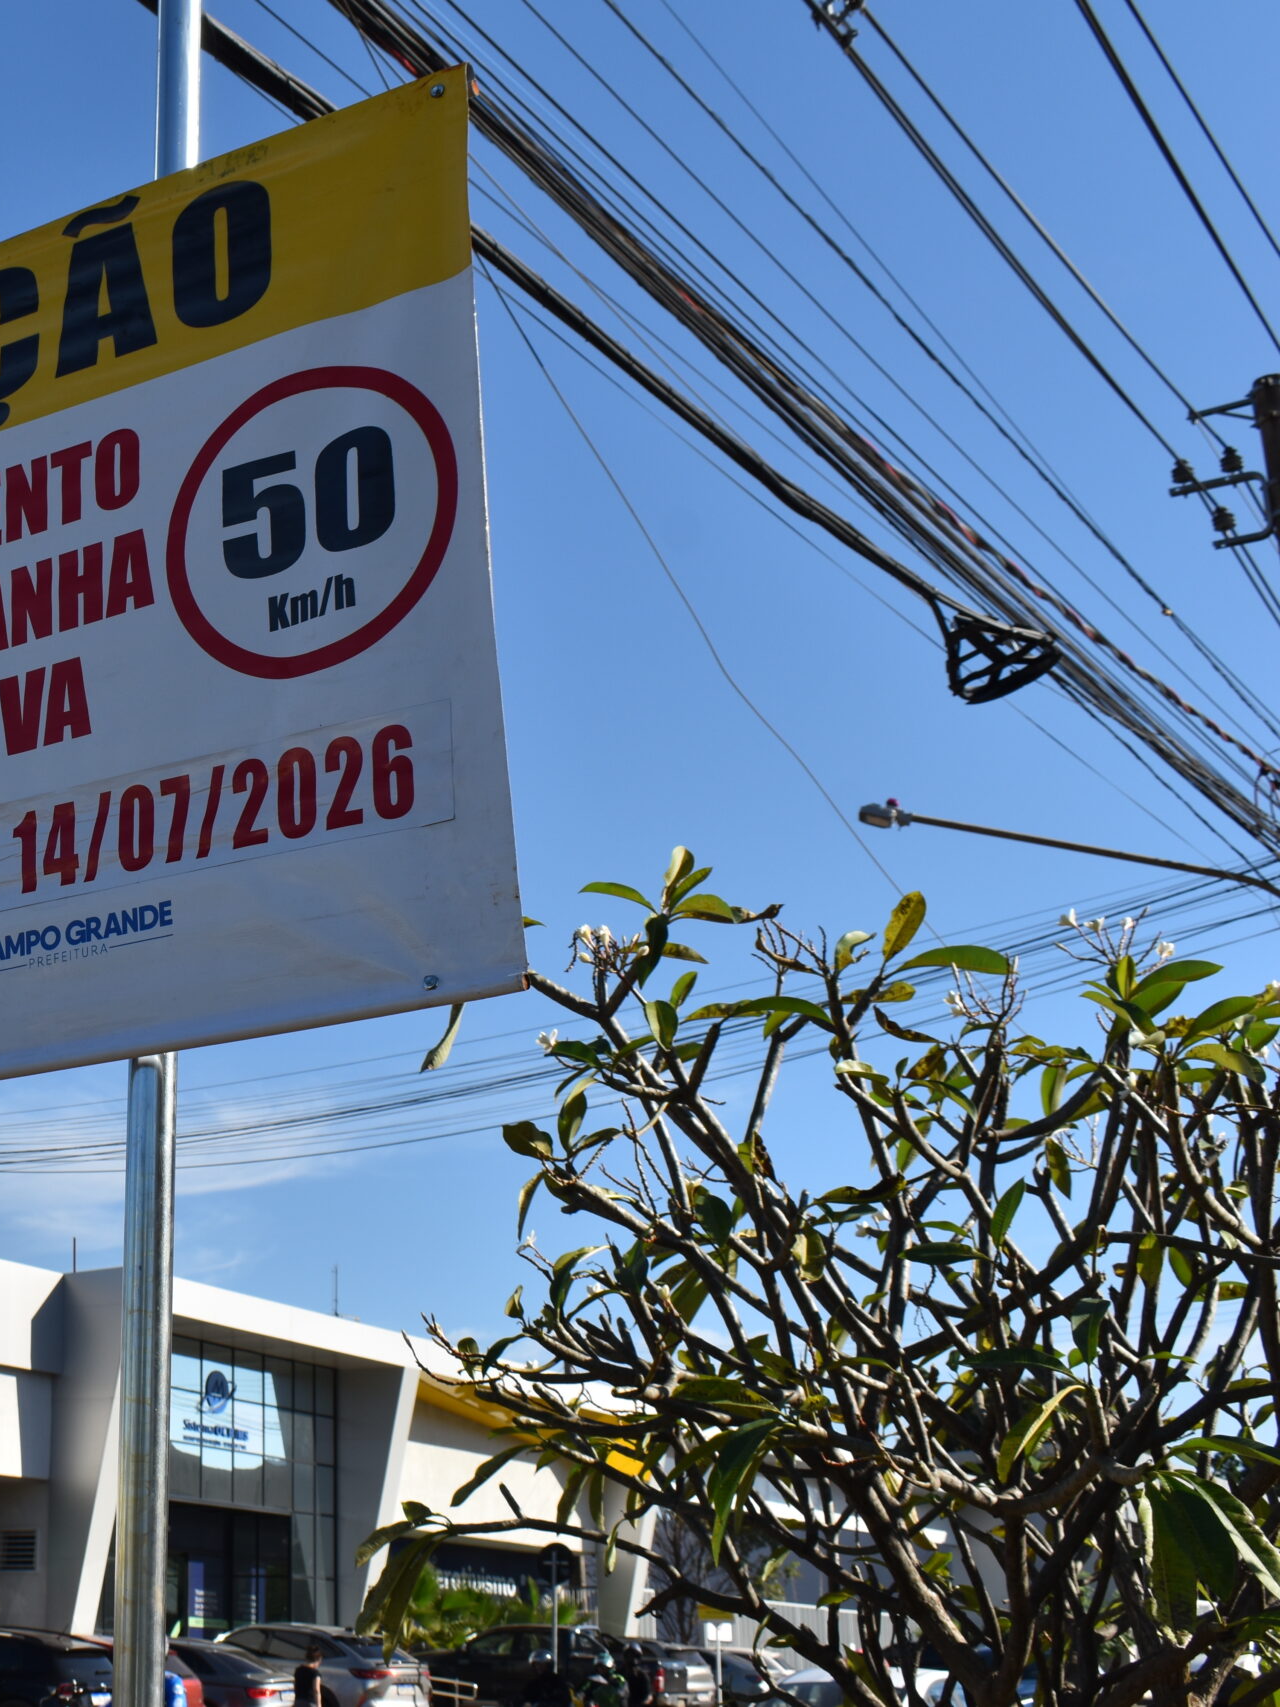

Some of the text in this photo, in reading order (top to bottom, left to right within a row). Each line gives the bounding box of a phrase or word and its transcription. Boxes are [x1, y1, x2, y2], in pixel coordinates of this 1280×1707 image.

[222, 425, 396, 580] 50
[267, 572, 357, 633] Km/h
[12, 723, 416, 895] 14/07/2026
[65, 899, 174, 947] GRANDE
[28, 942, 109, 970] PREFEITURA
